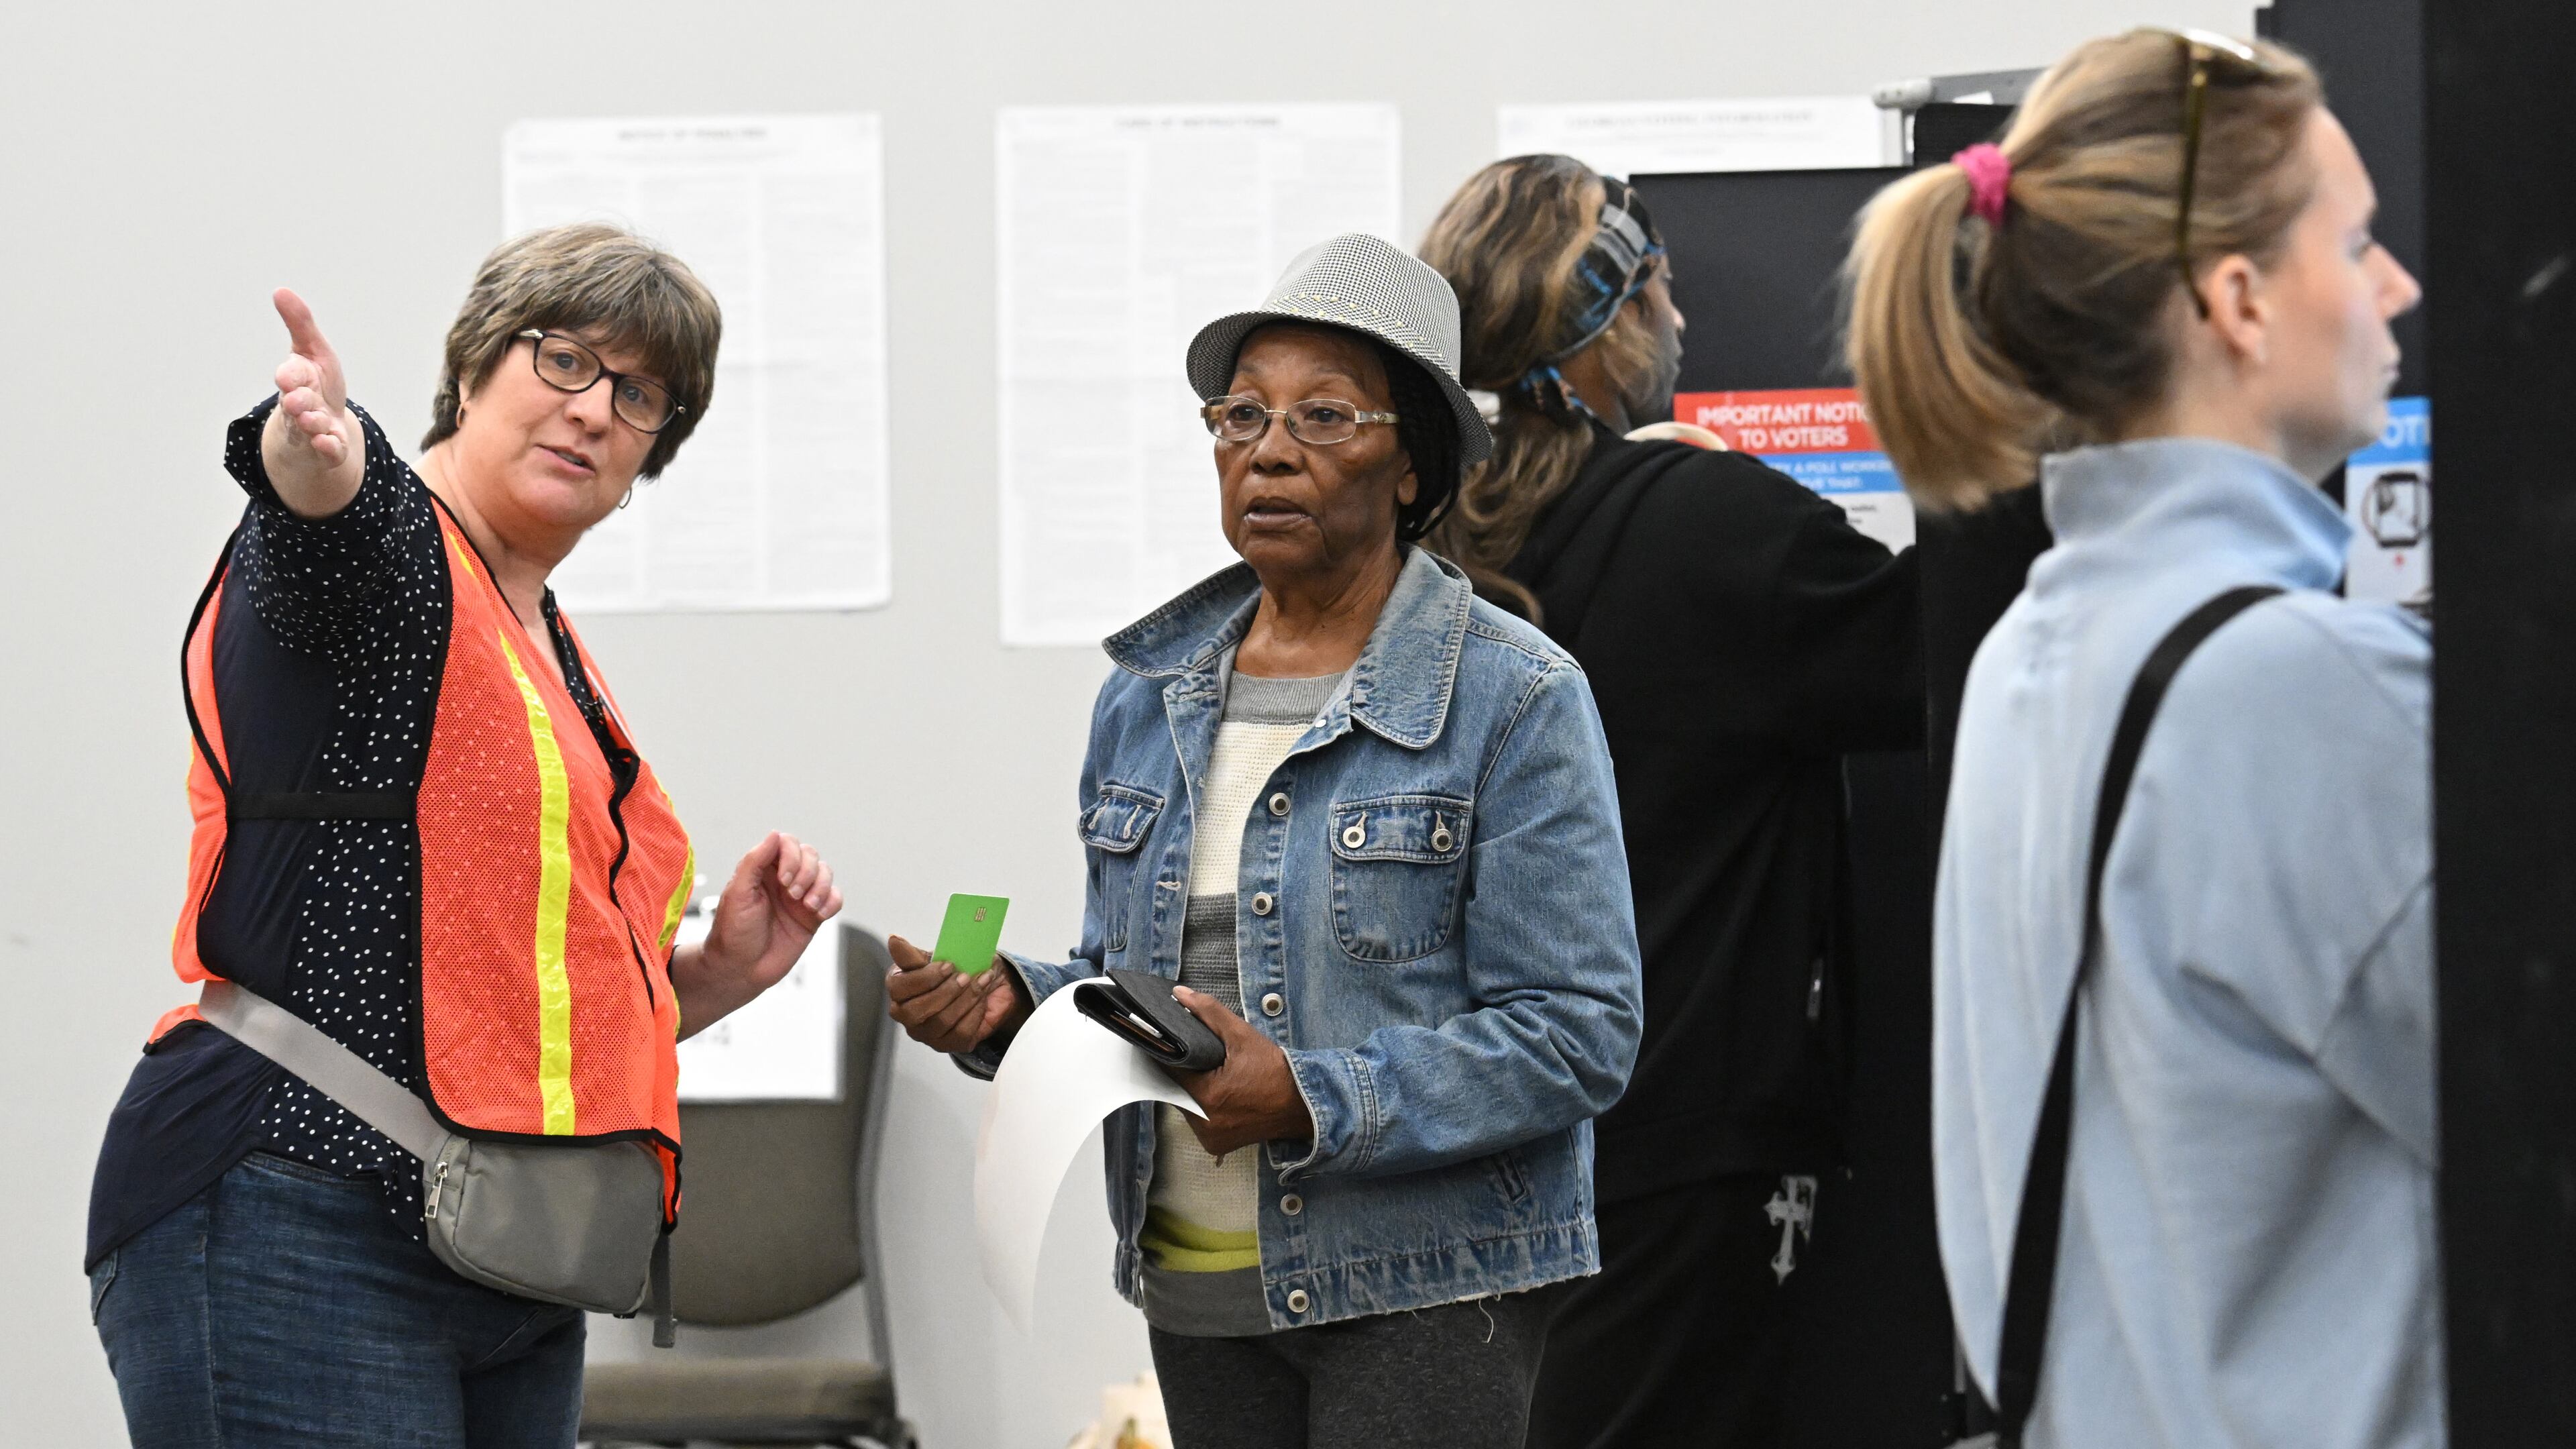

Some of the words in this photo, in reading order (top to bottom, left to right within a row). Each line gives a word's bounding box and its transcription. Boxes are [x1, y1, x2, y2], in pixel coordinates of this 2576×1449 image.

[1696, 404, 1811, 425] IMPORTANT
[1739, 427, 1768, 449] TO
[1769, 425, 1848, 449] VOTERS
